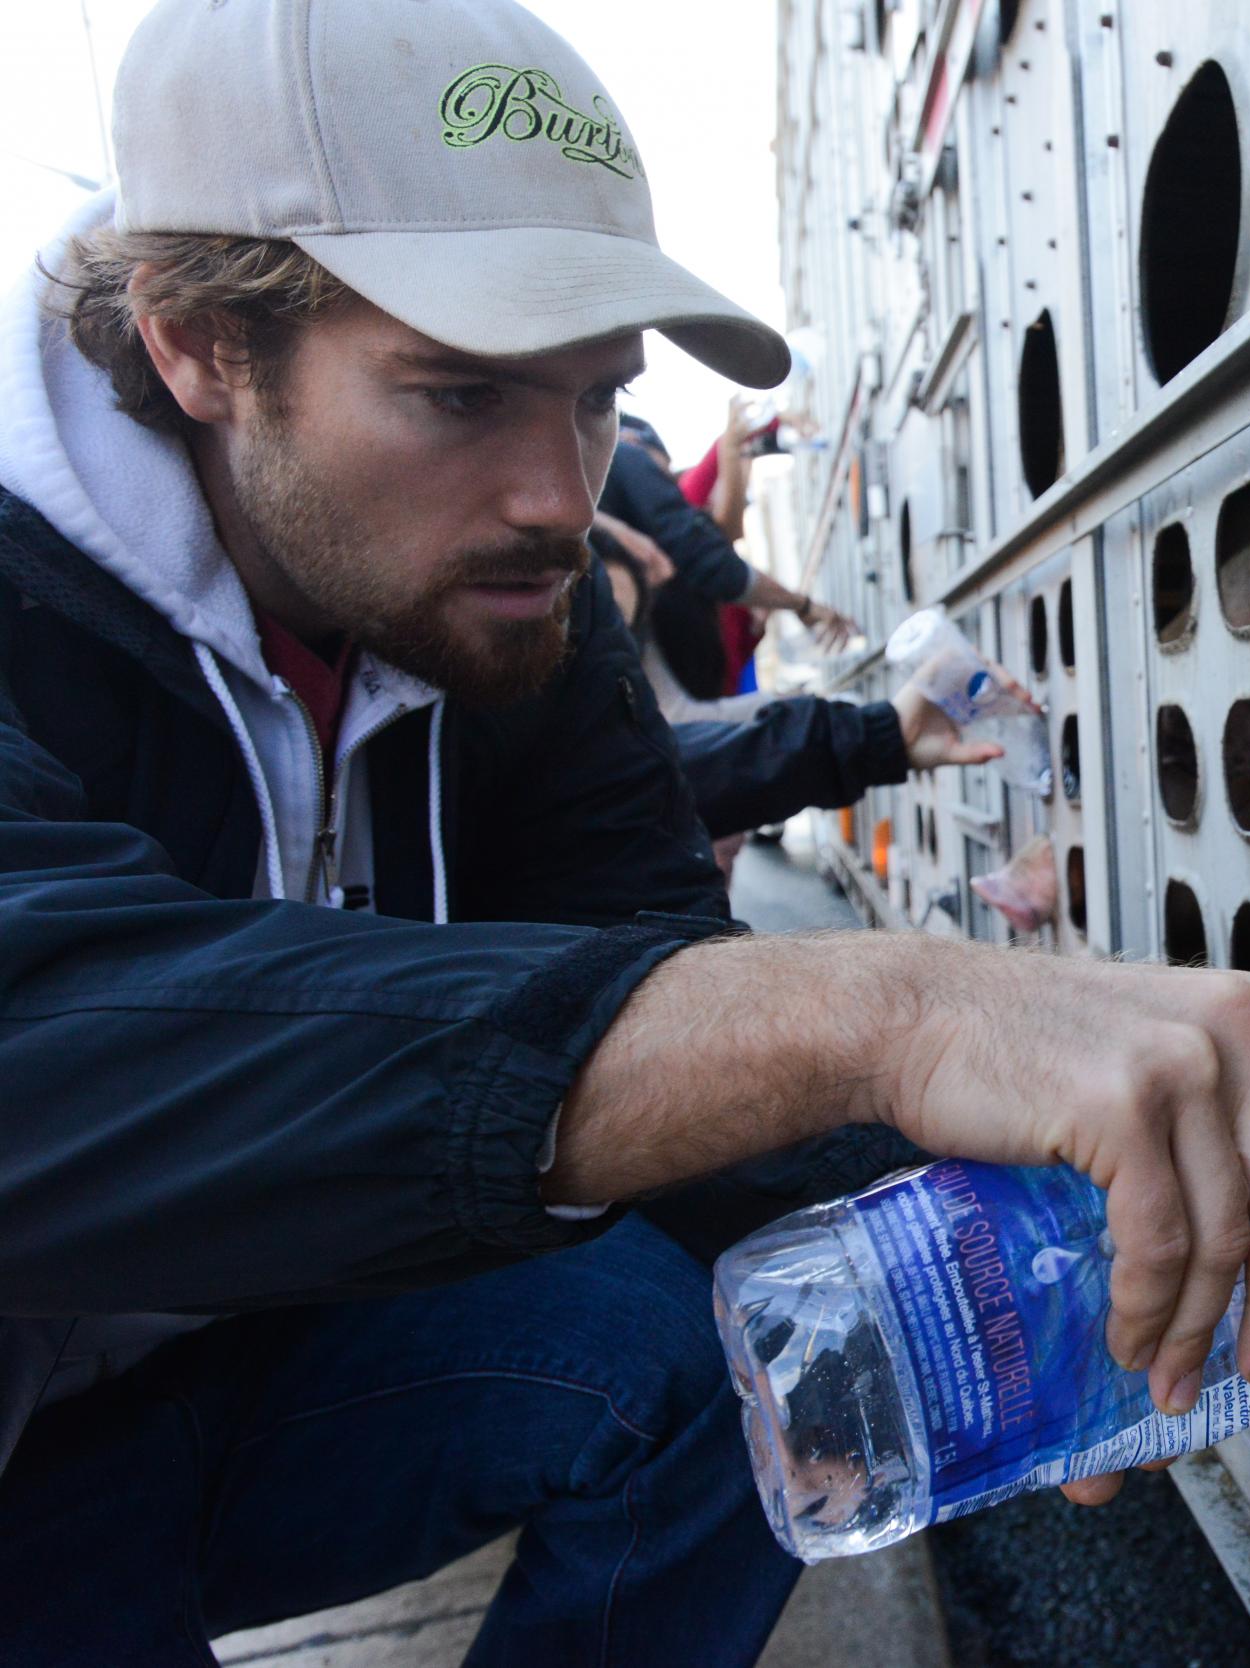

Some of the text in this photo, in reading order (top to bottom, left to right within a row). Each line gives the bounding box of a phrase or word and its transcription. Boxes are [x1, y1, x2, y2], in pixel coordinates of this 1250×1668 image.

[922, 1265, 952, 1322] protégées
[927, 1164, 1033, 1432] EAU DE SOURCE NATURELLE
[933, 1227, 952, 1261] filtrée.
[945, 1261, 977, 1334] Embouteillée
[968, 1334, 980, 1345] à
[944, 1322, 956, 1338] au
[950, 1338, 966, 1368] Nord
[956, 1368, 969, 1385] du
[1212, 1386, 1220, 1402] Per
[959, 1385, 974, 1430] Québec.
[1212, 1403, 1221, 1416] 500
[1223, 1381, 1236, 1422] Valeur
